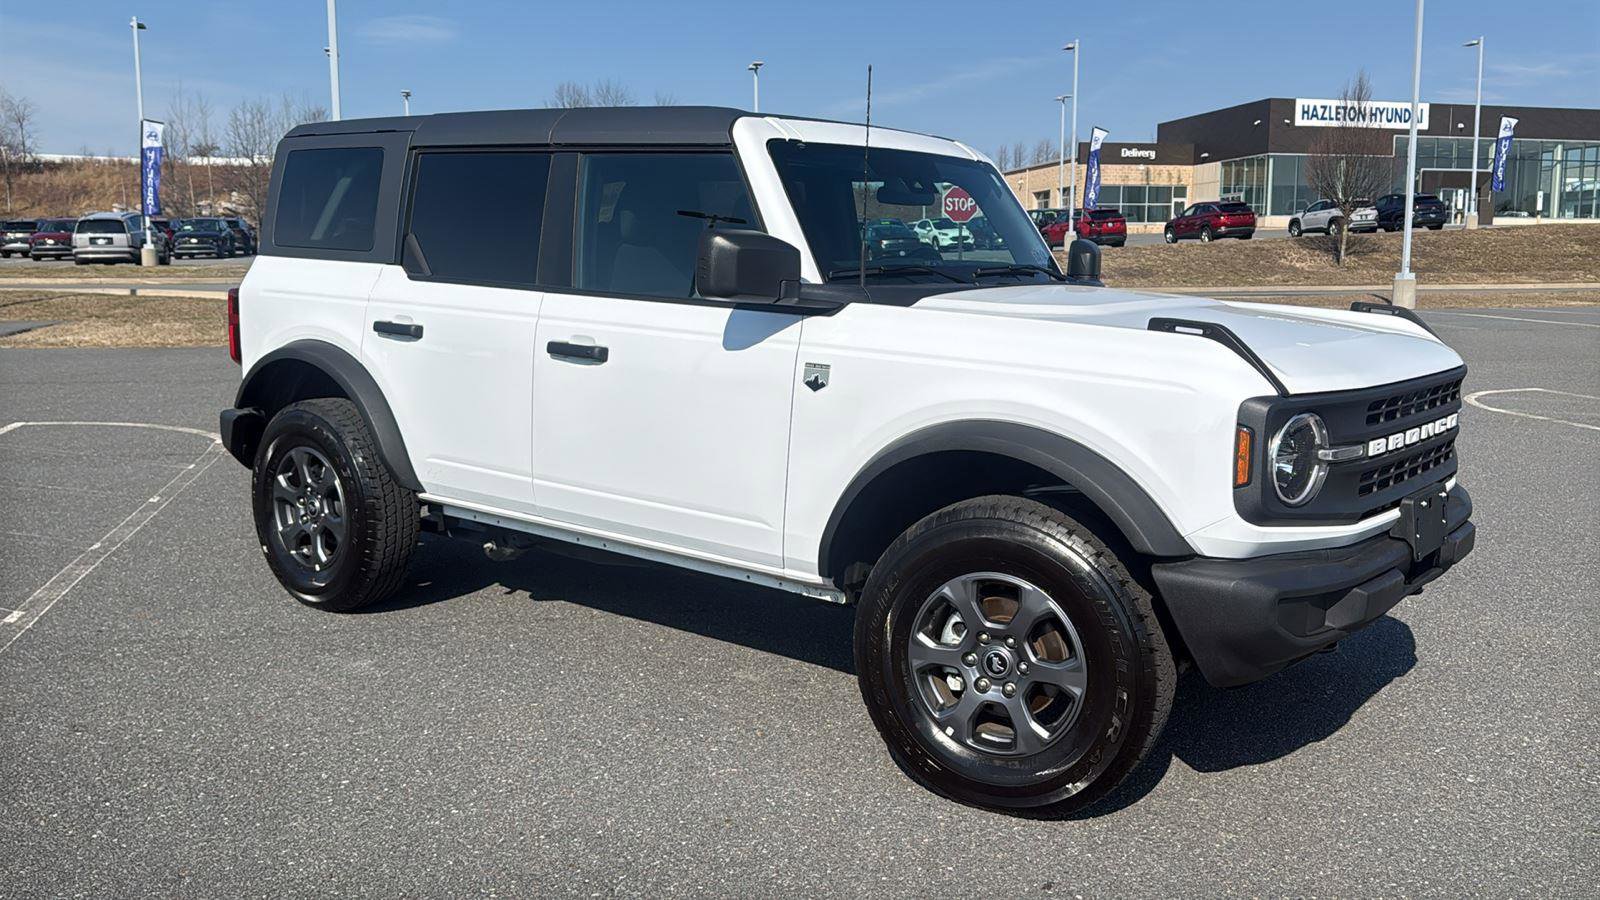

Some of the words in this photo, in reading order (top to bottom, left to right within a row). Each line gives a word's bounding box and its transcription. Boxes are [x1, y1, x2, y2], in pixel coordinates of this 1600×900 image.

[1302, 104, 1366, 122] HAZLETON
[1369, 107, 1423, 124] HYUNDI
[1121, 148, 1156, 160] Delivery
[945, 197, 976, 212] STOP
[1367, 413, 1459, 457] BRONCO
